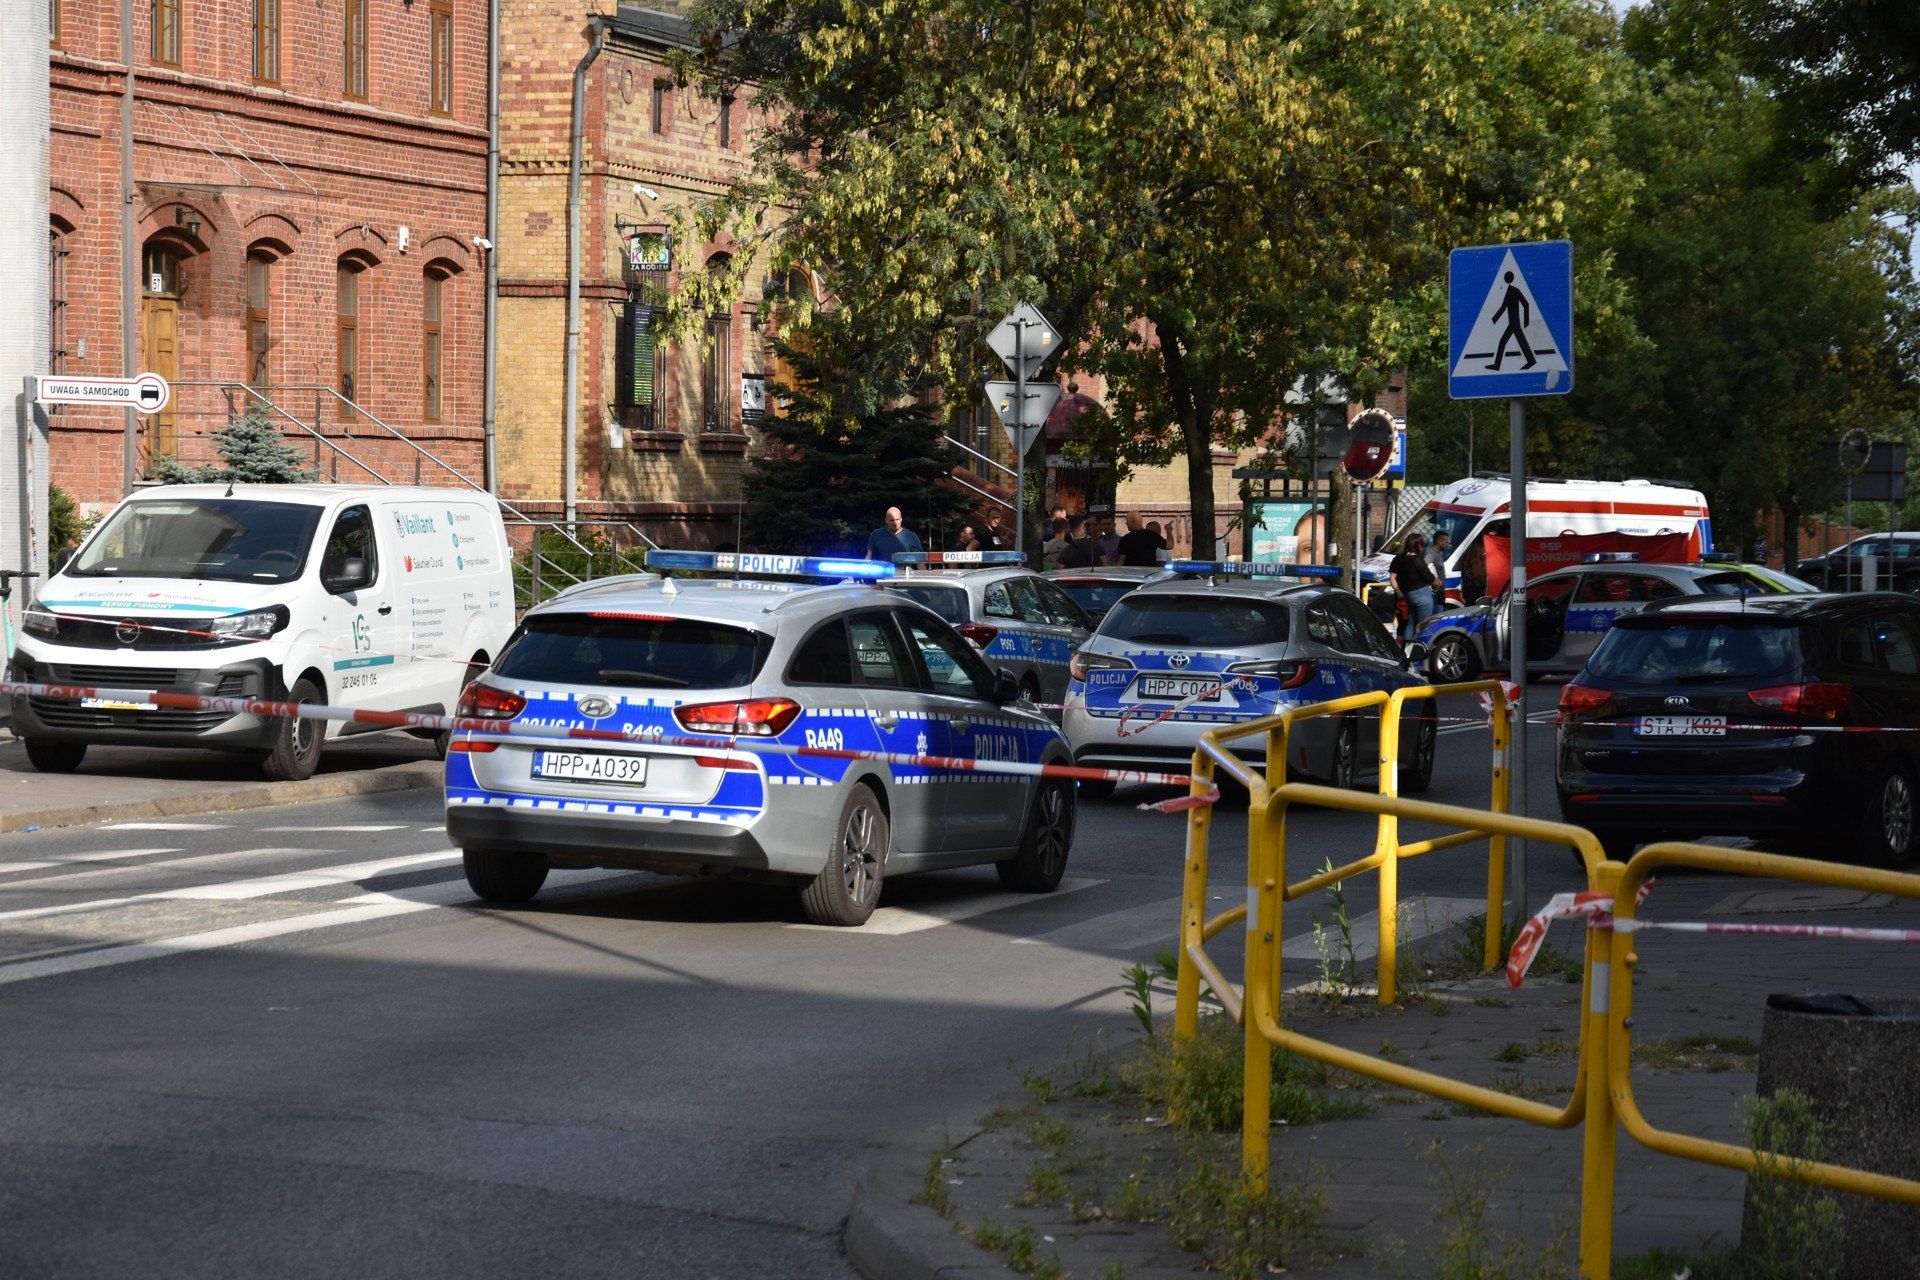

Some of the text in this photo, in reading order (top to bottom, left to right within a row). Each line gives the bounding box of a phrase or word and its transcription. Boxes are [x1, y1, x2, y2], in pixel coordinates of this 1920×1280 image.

[50, 385, 130, 397] UWAGA SAMOCHÓD
[402, 513, 436, 534] Vaillant
[1541, 542, 1562, 551] PSP
[945, 553, 980, 561] POLICJA
[742, 556, 803, 574] POLICJA
[1241, 563, 1285, 575] POLICJA
[1090, 674, 1127, 684] POLICJA
[1147, 681, 1176, 695] HPP
[1668, 697, 1685, 705] KIA
[1644, 717, 1674, 734] STA
[805, 728, 844, 750] R449
[974, 734, 1019, 762] POLICJA
[546, 753, 584, 775] HPP
[591, 757, 641, 780] A039
